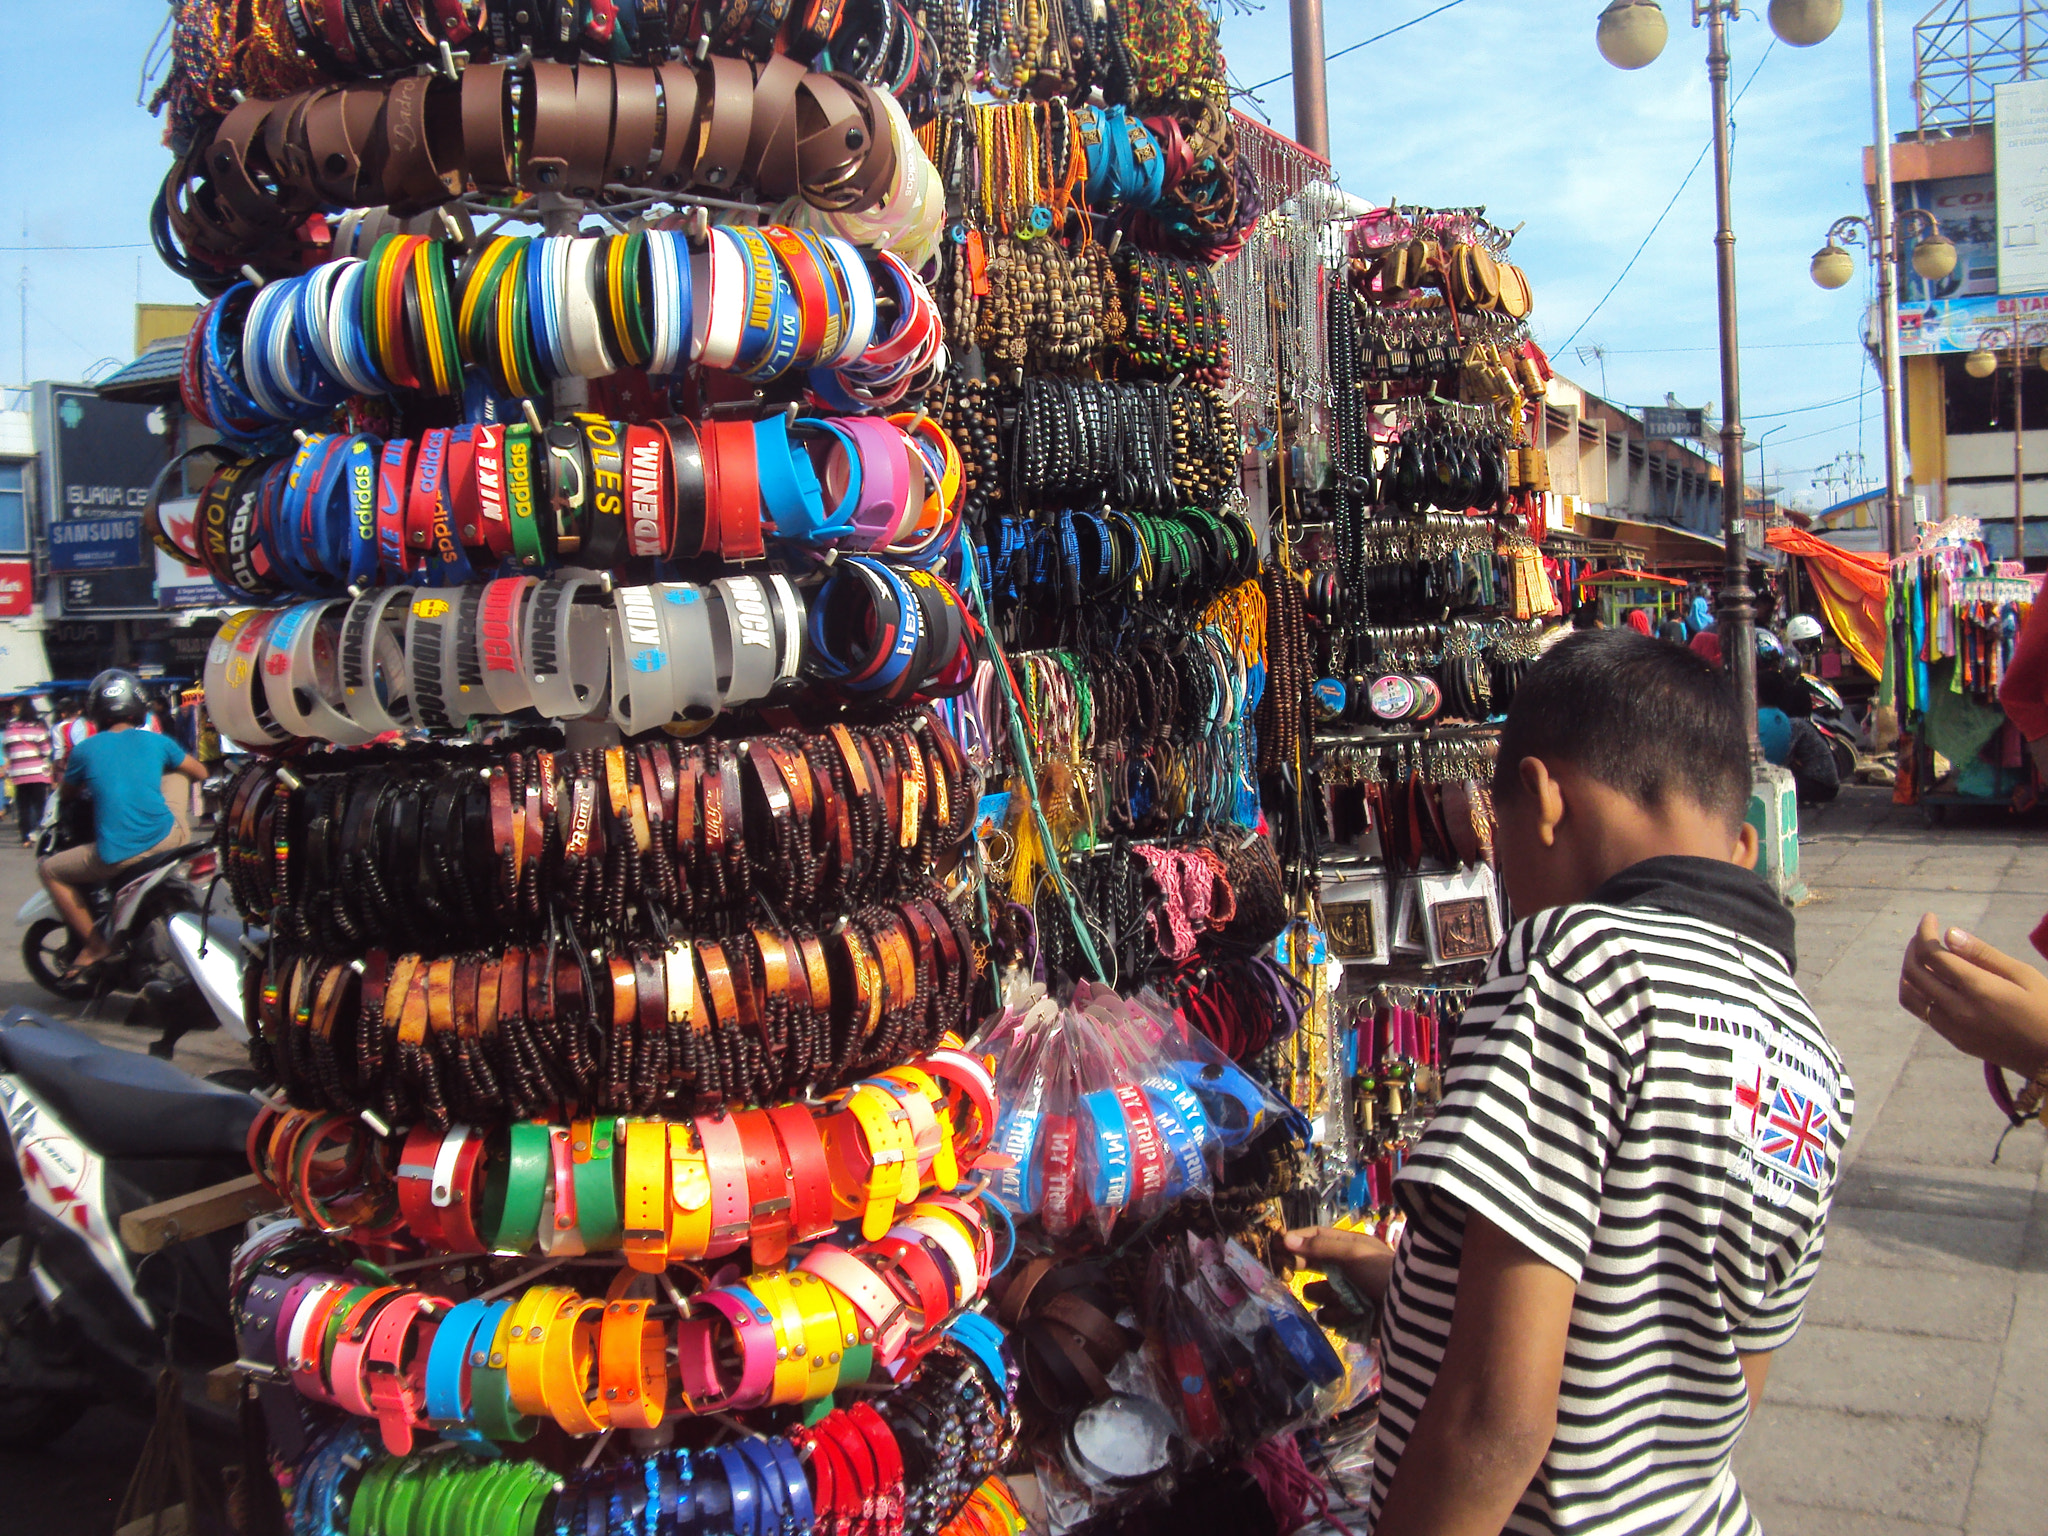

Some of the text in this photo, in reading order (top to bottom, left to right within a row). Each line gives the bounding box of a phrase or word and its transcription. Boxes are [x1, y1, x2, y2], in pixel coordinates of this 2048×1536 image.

[905, 152, 916, 197] adidas
[744, 236, 773, 331] JUVENTUS
[420, 432, 445, 492] adidas
[479, 456, 503, 521] NIKE
[509, 443, 532, 517] adidas
[573, 412, 623, 515] WOLES
[53, 521, 135, 544] SAMSUNG
[354, 465, 373, 540] adidas
[1117, 1086, 1143, 1108] MY
[1131, 1113, 1158, 1160] TRIP
[1174, 1091, 1200, 1121] MY
[1047, 1133, 1070, 1166] MY
[1156, 1112, 1185, 1136] MY
[1179, 1139, 1203, 1183] TRIP
[1001, 1167, 1021, 1198] MY
